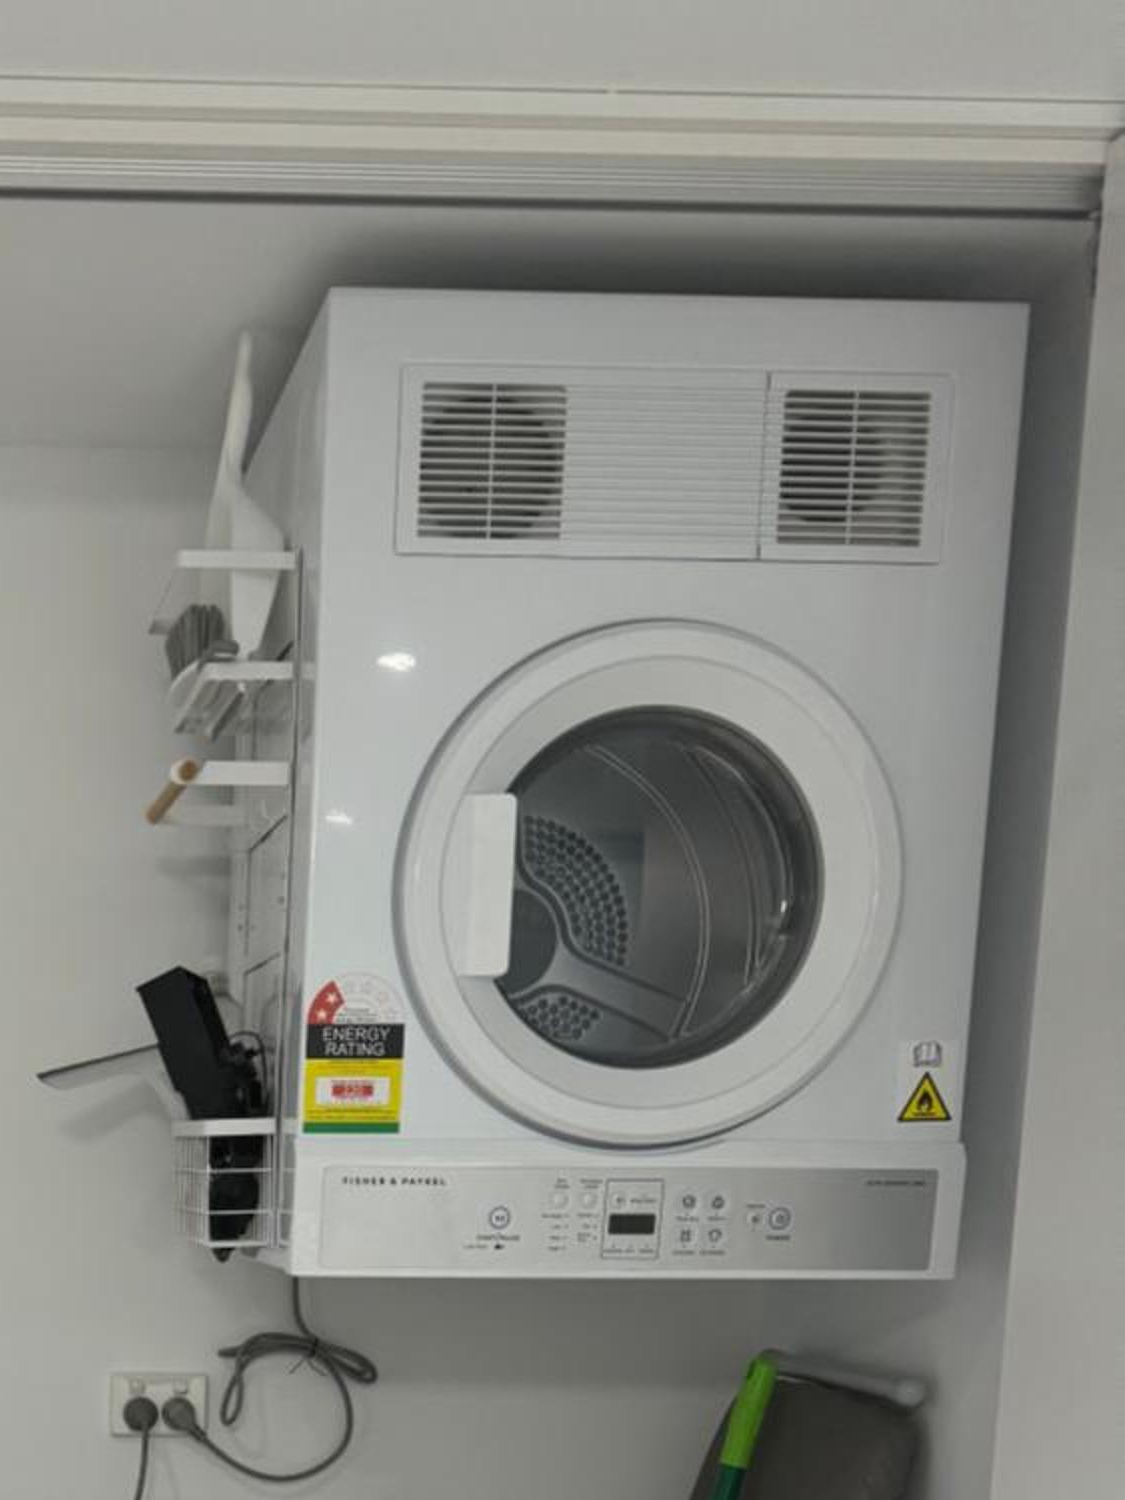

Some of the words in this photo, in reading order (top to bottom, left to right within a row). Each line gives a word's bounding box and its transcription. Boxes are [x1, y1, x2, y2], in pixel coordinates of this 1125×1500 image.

[322, 1027, 390, 1041] ENERGY
[324, 1042, 386, 1057] RATING
[342, 1176, 386, 1185] FISHER
